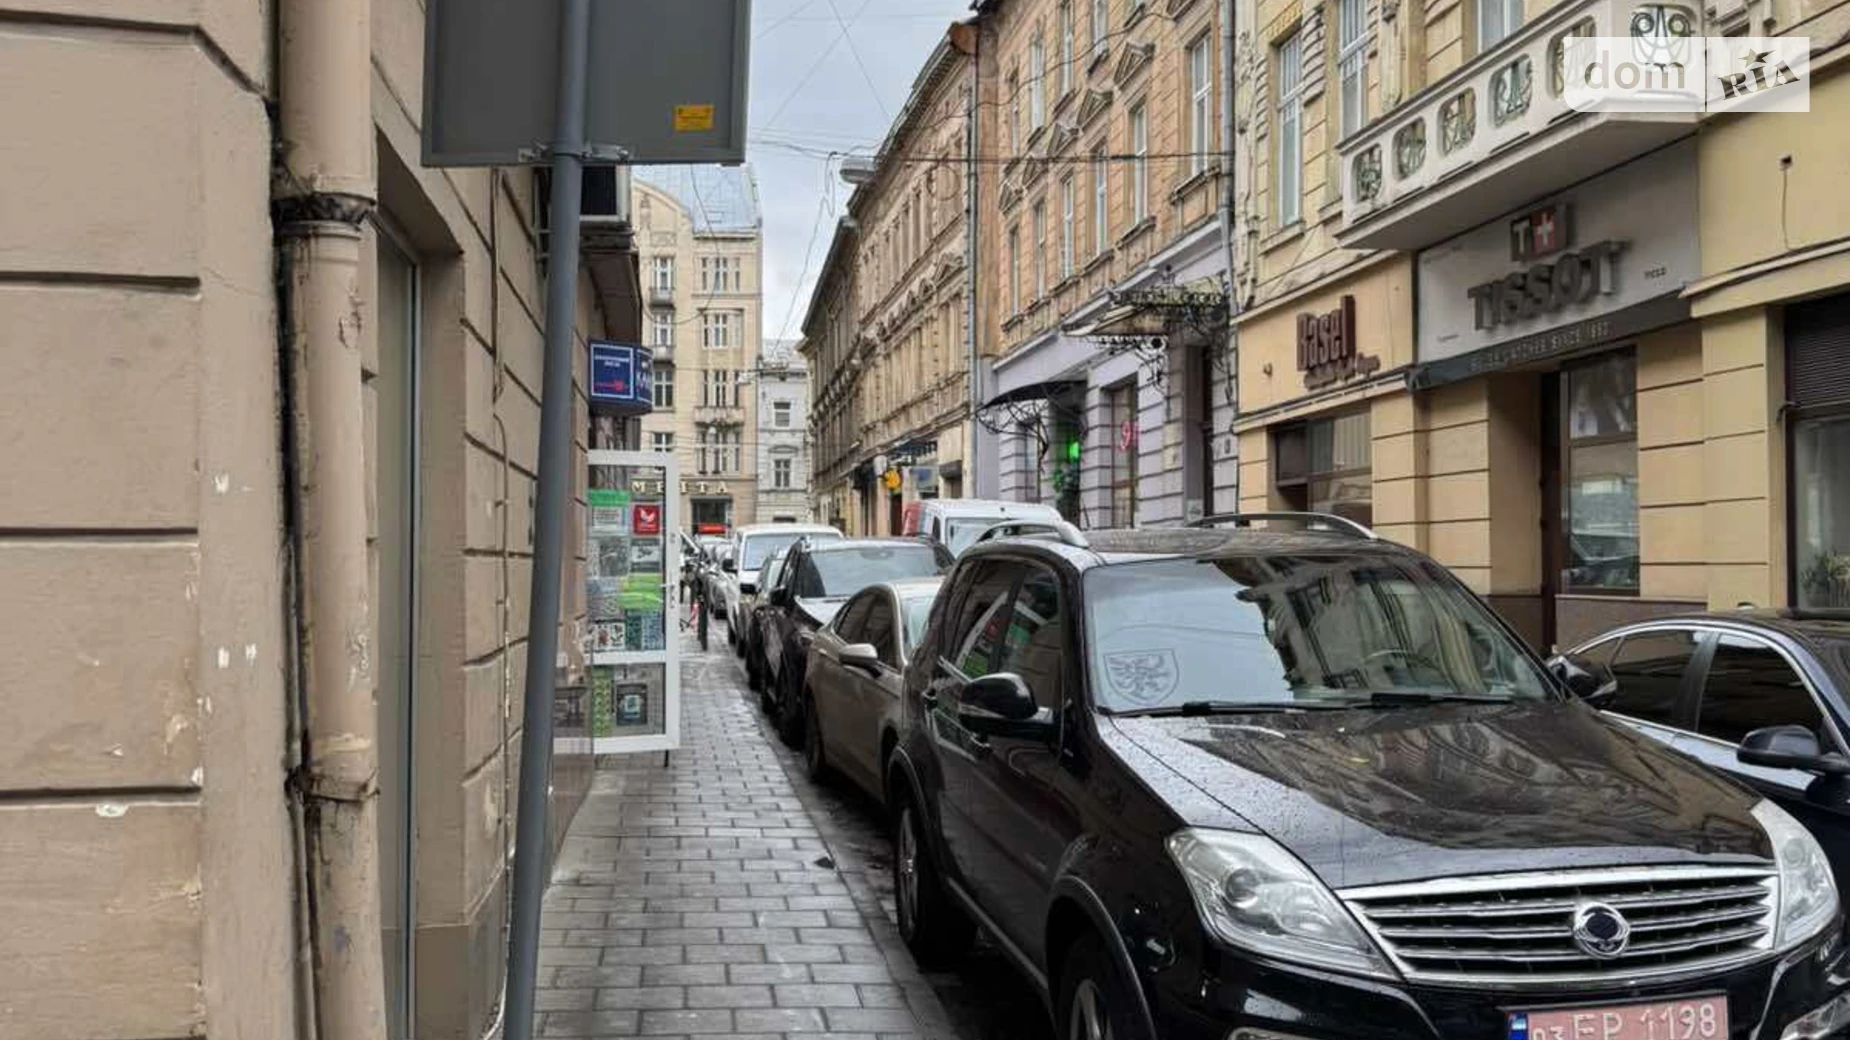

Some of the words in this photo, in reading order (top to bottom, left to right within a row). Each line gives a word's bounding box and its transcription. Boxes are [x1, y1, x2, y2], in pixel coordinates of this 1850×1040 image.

[1468, 237, 1632, 331] TISSOT
[1297, 295, 1356, 372] Basel
[1641, 1003, 1716, 1040] 1198
